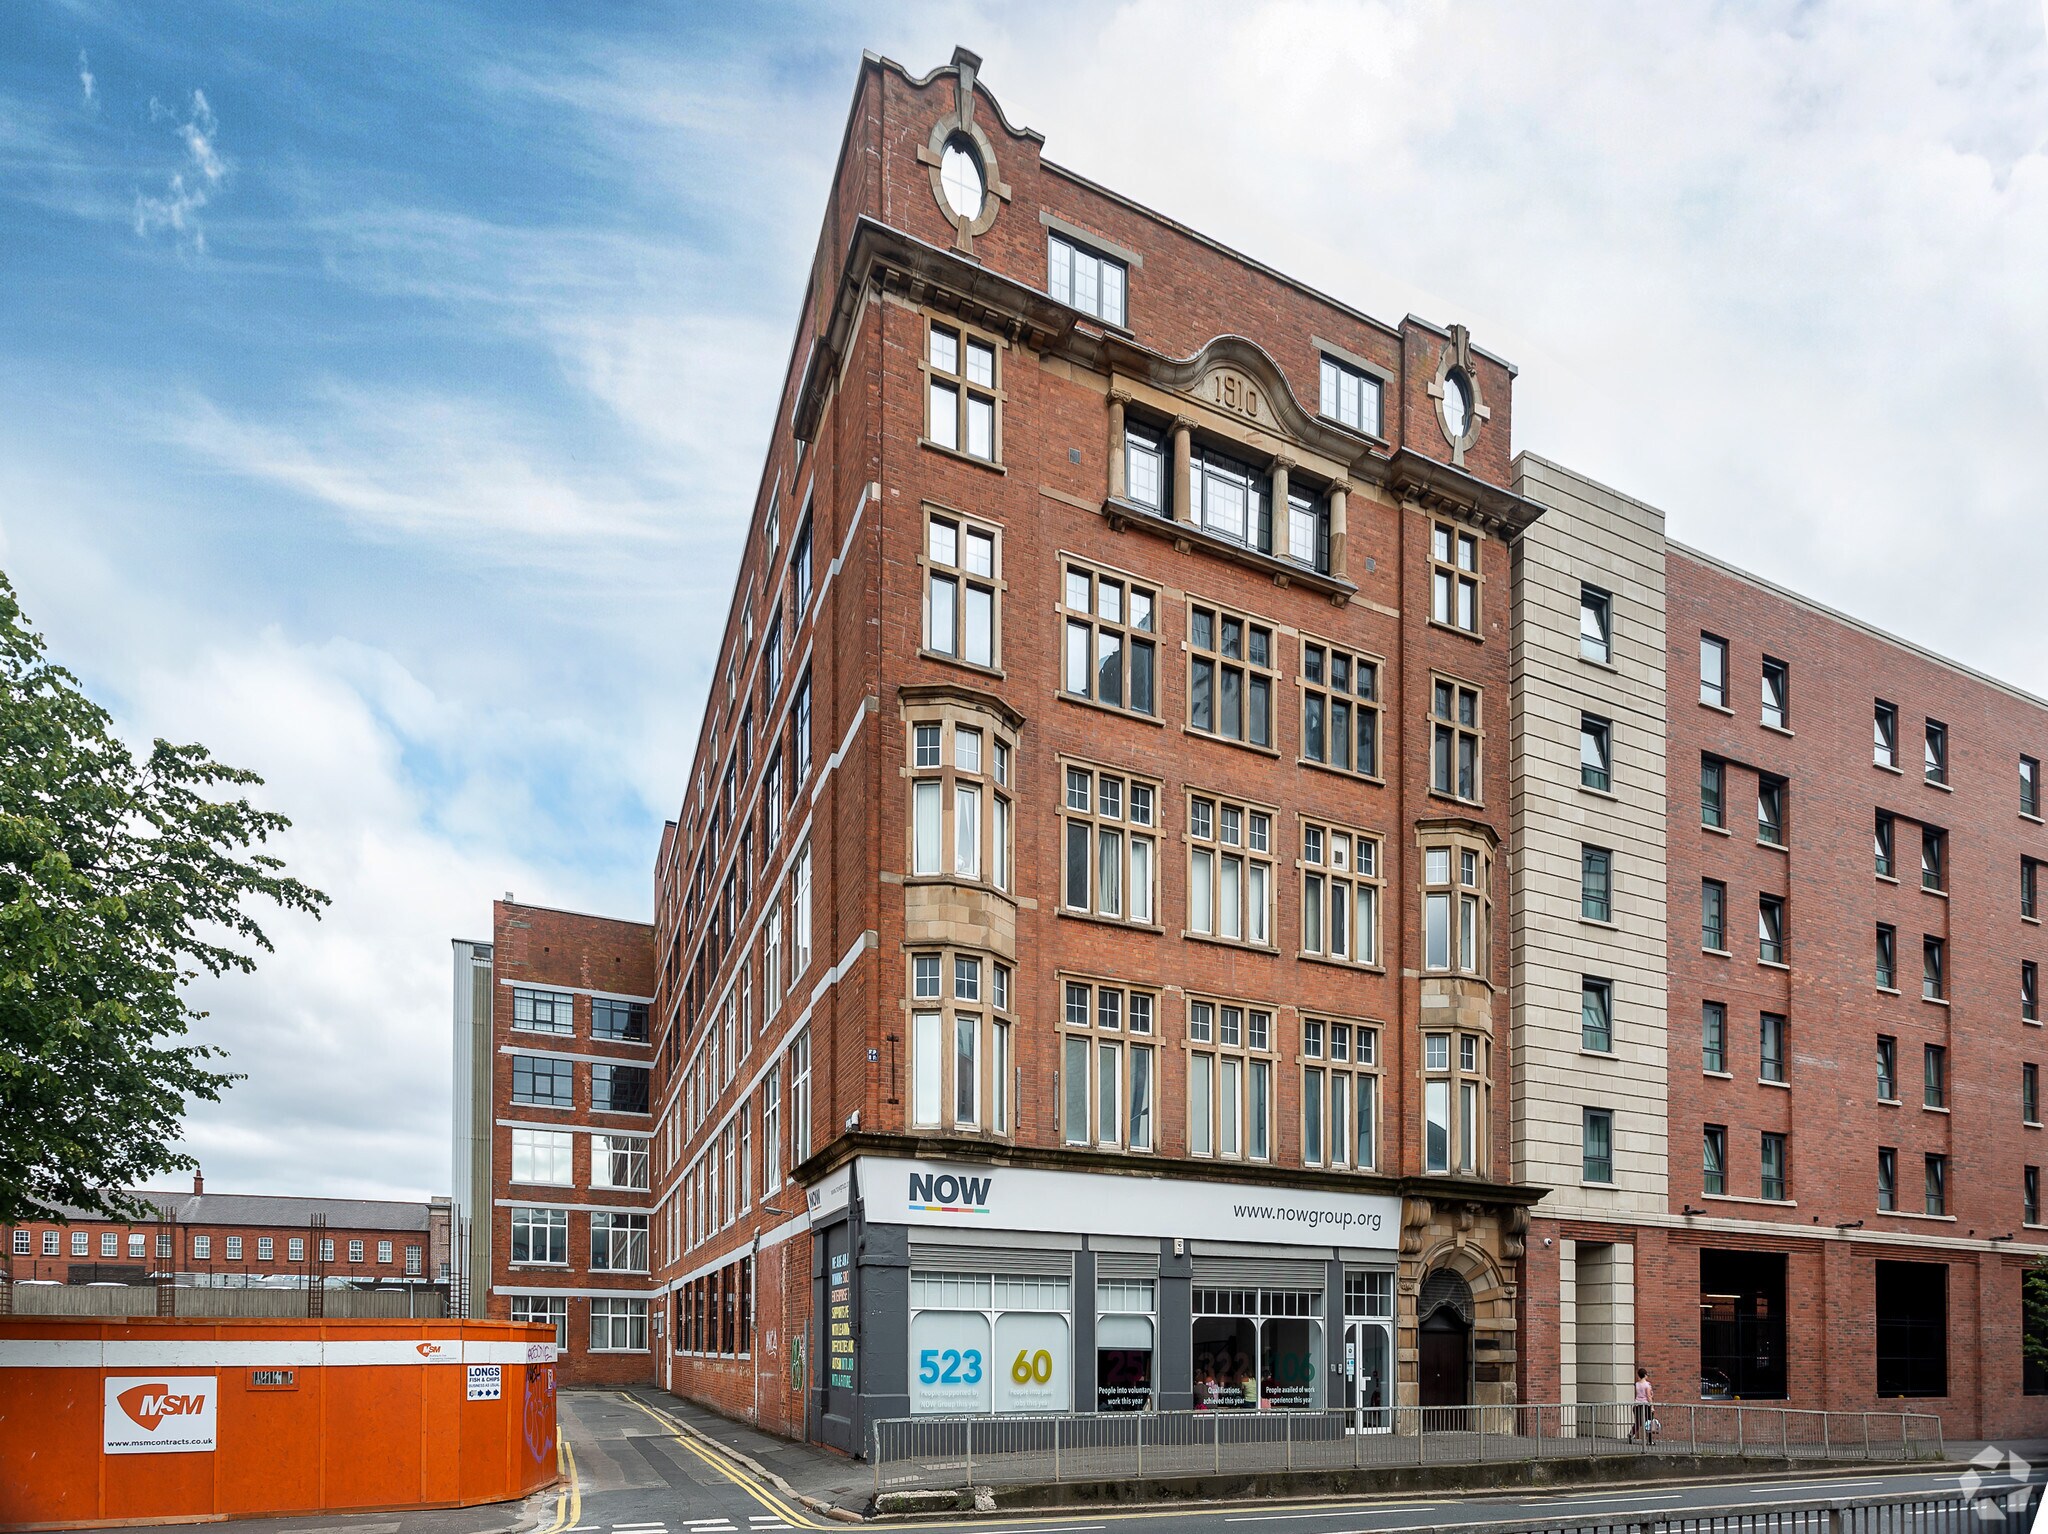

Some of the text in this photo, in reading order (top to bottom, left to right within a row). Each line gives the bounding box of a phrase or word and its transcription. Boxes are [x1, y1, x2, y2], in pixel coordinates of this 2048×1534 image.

[1215, 375, 1257, 418] 1910
[908, 1172, 992, 1206] NOW
[808, 1187, 821, 1209] NOW
[1233, 1204, 1382, 1232] www.nowgroup.org
[422, 1345, 441, 1354] MSM
[919, 1348, 983, 1384] 523
[1012, 1349, 1053, 1384] 60
[1107, 1350, 1144, 1383] 25
[1269, 1351, 1316, 1383] 106
[469, 1367, 500, 1377] LONGS
[920, 1388, 979, 1398] People supported by
[1009, 1387, 1028, 1397] People
[1029, 1387, 1041, 1396] into
[1098, 1385, 1152, 1396] People into voluntary
[1207, 1386, 1240, 1395] Qualifications
[1266, 1386, 1316, 1395] People availed of work
[139, 1394, 205, 1416] MSM
[937, 1400, 956, 1410] Group
[956, 1399, 967, 1408] this
[1107, 1396, 1143, 1406] work this year
[1203, 1397, 1245, 1406] achieved this year
[1293, 1397, 1303, 1405] this
[1302, 1398, 1313, 1406] year
[107, 1438, 213, 1448] www.msmcontracts.co.uk
